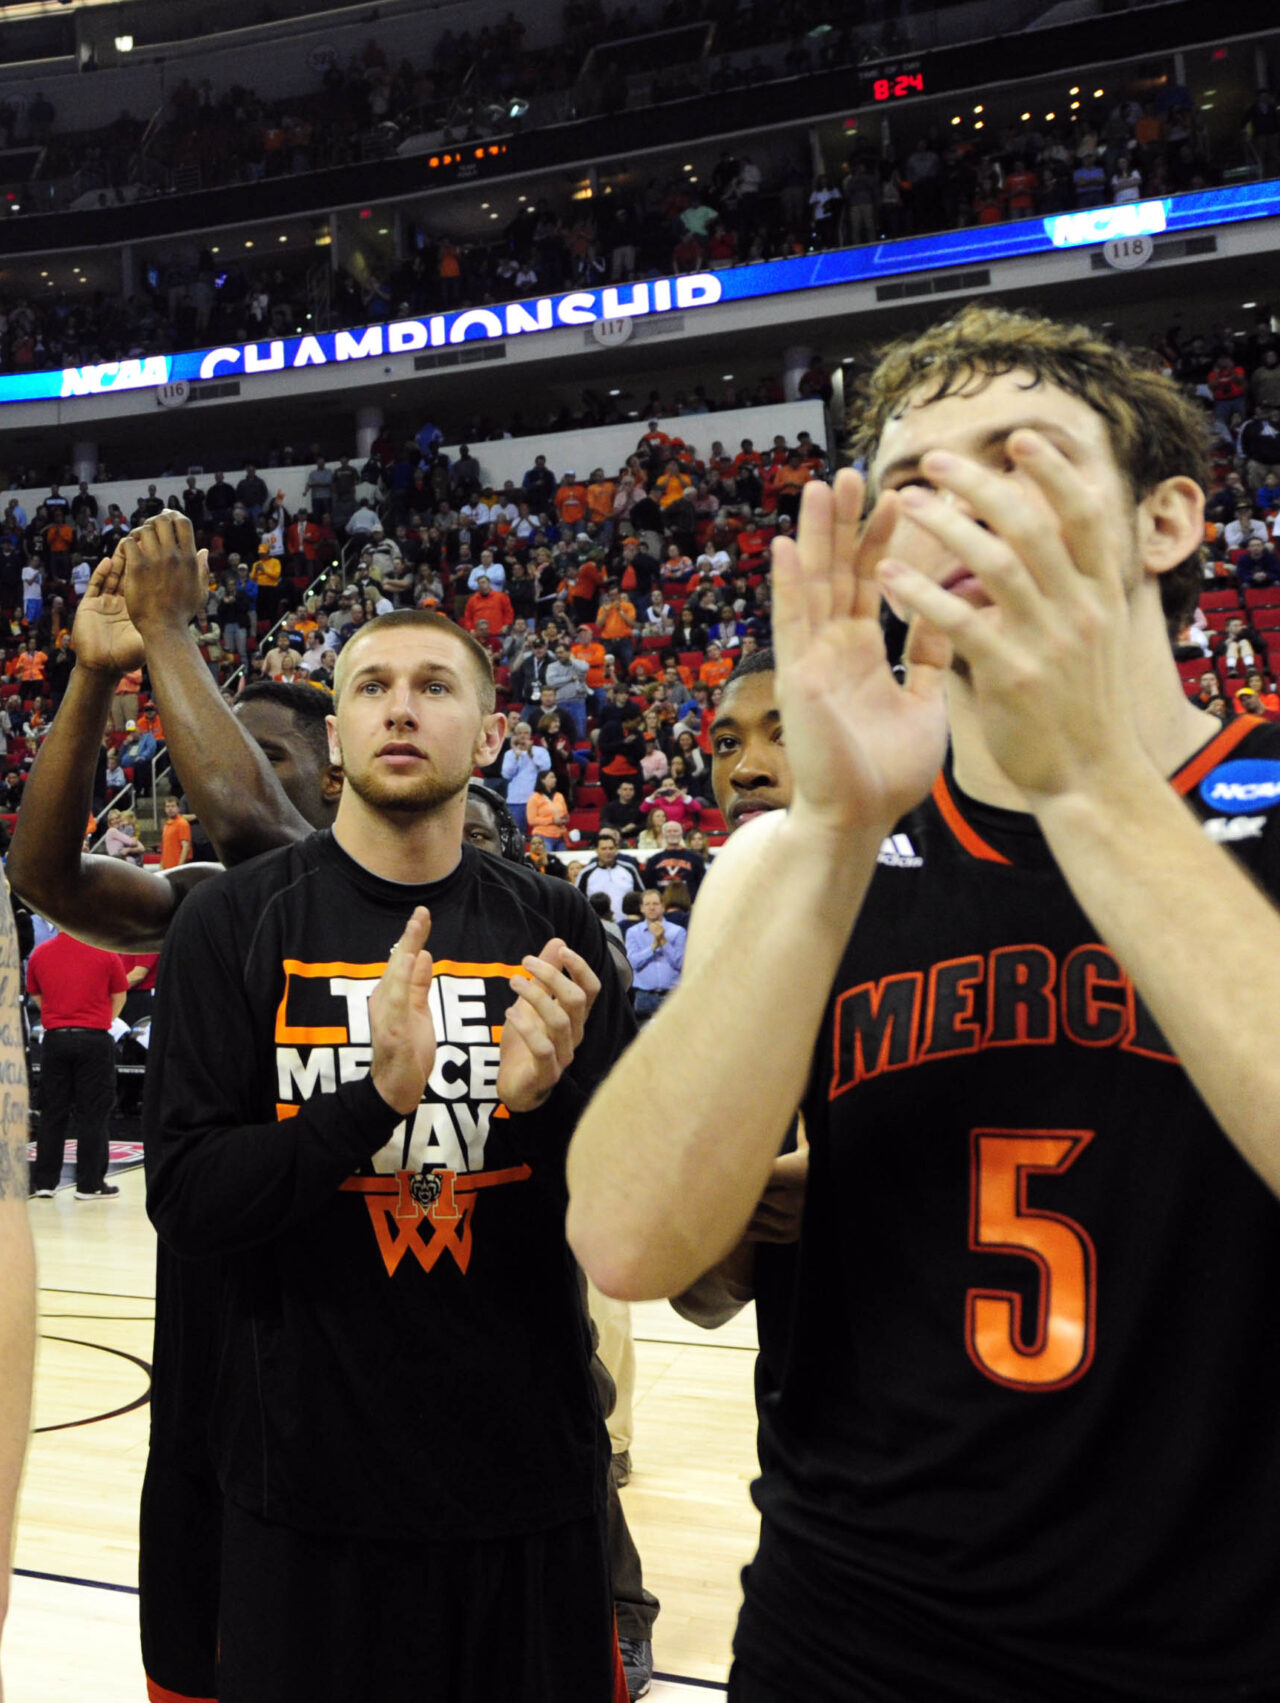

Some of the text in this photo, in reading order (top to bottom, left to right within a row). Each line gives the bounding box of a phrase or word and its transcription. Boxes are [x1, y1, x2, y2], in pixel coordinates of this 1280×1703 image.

[873, 72, 924, 101] 8:24
[1053, 200, 1166, 246] NCAA
[1112, 239, 1144, 259] 118
[599, 321, 624, 337] 117
[60, 354, 168, 398] NCAA
[162, 382, 185, 399] 116
[1210, 781, 1280, 800] NCA
[828, 943, 1180, 1101] MERC
[963, 1128, 1097, 1394] 5
